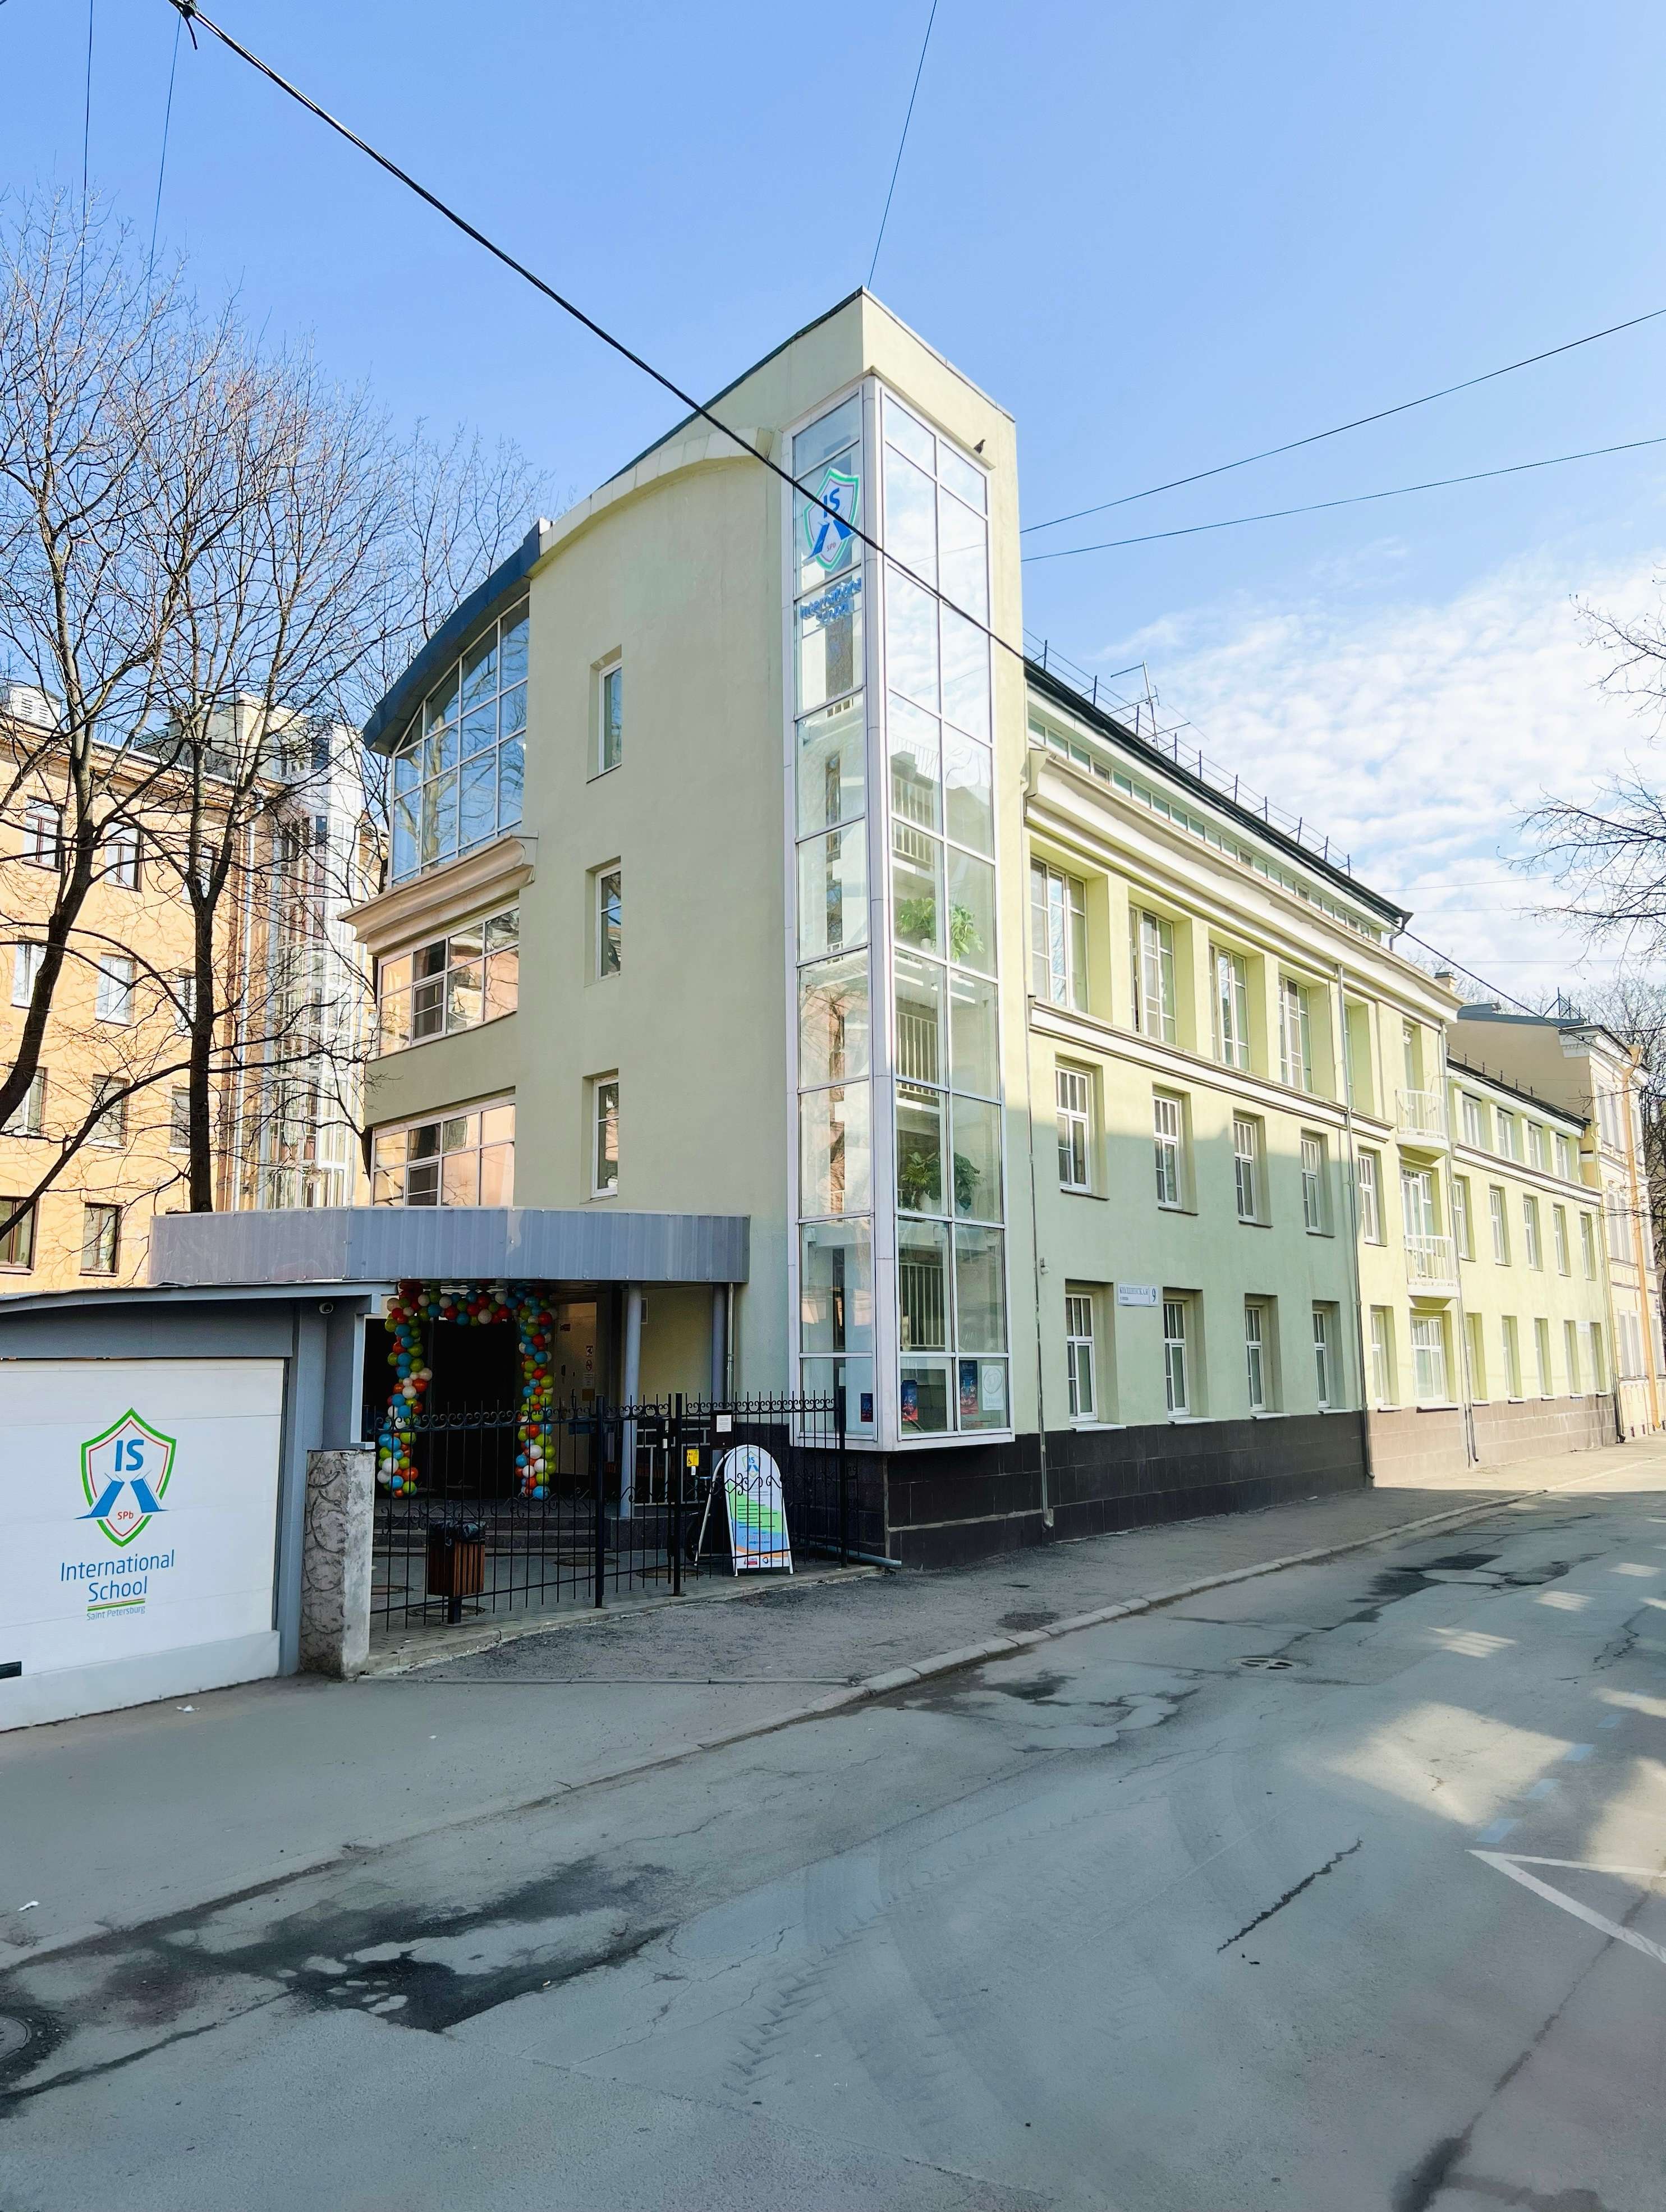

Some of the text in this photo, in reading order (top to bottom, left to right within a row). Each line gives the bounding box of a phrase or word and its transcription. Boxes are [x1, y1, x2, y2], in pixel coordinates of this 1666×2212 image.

[823, 487, 840, 518] IS
[1151, 1288, 1156, 1302] 9
[115, 1439, 144, 1471] IS
[117, 1511, 134, 1520] SPb
[61, 1549, 174, 1581] International
[88, 1576, 147, 1602] School
[86, 1605, 145, 1621] Saint Petersburg
